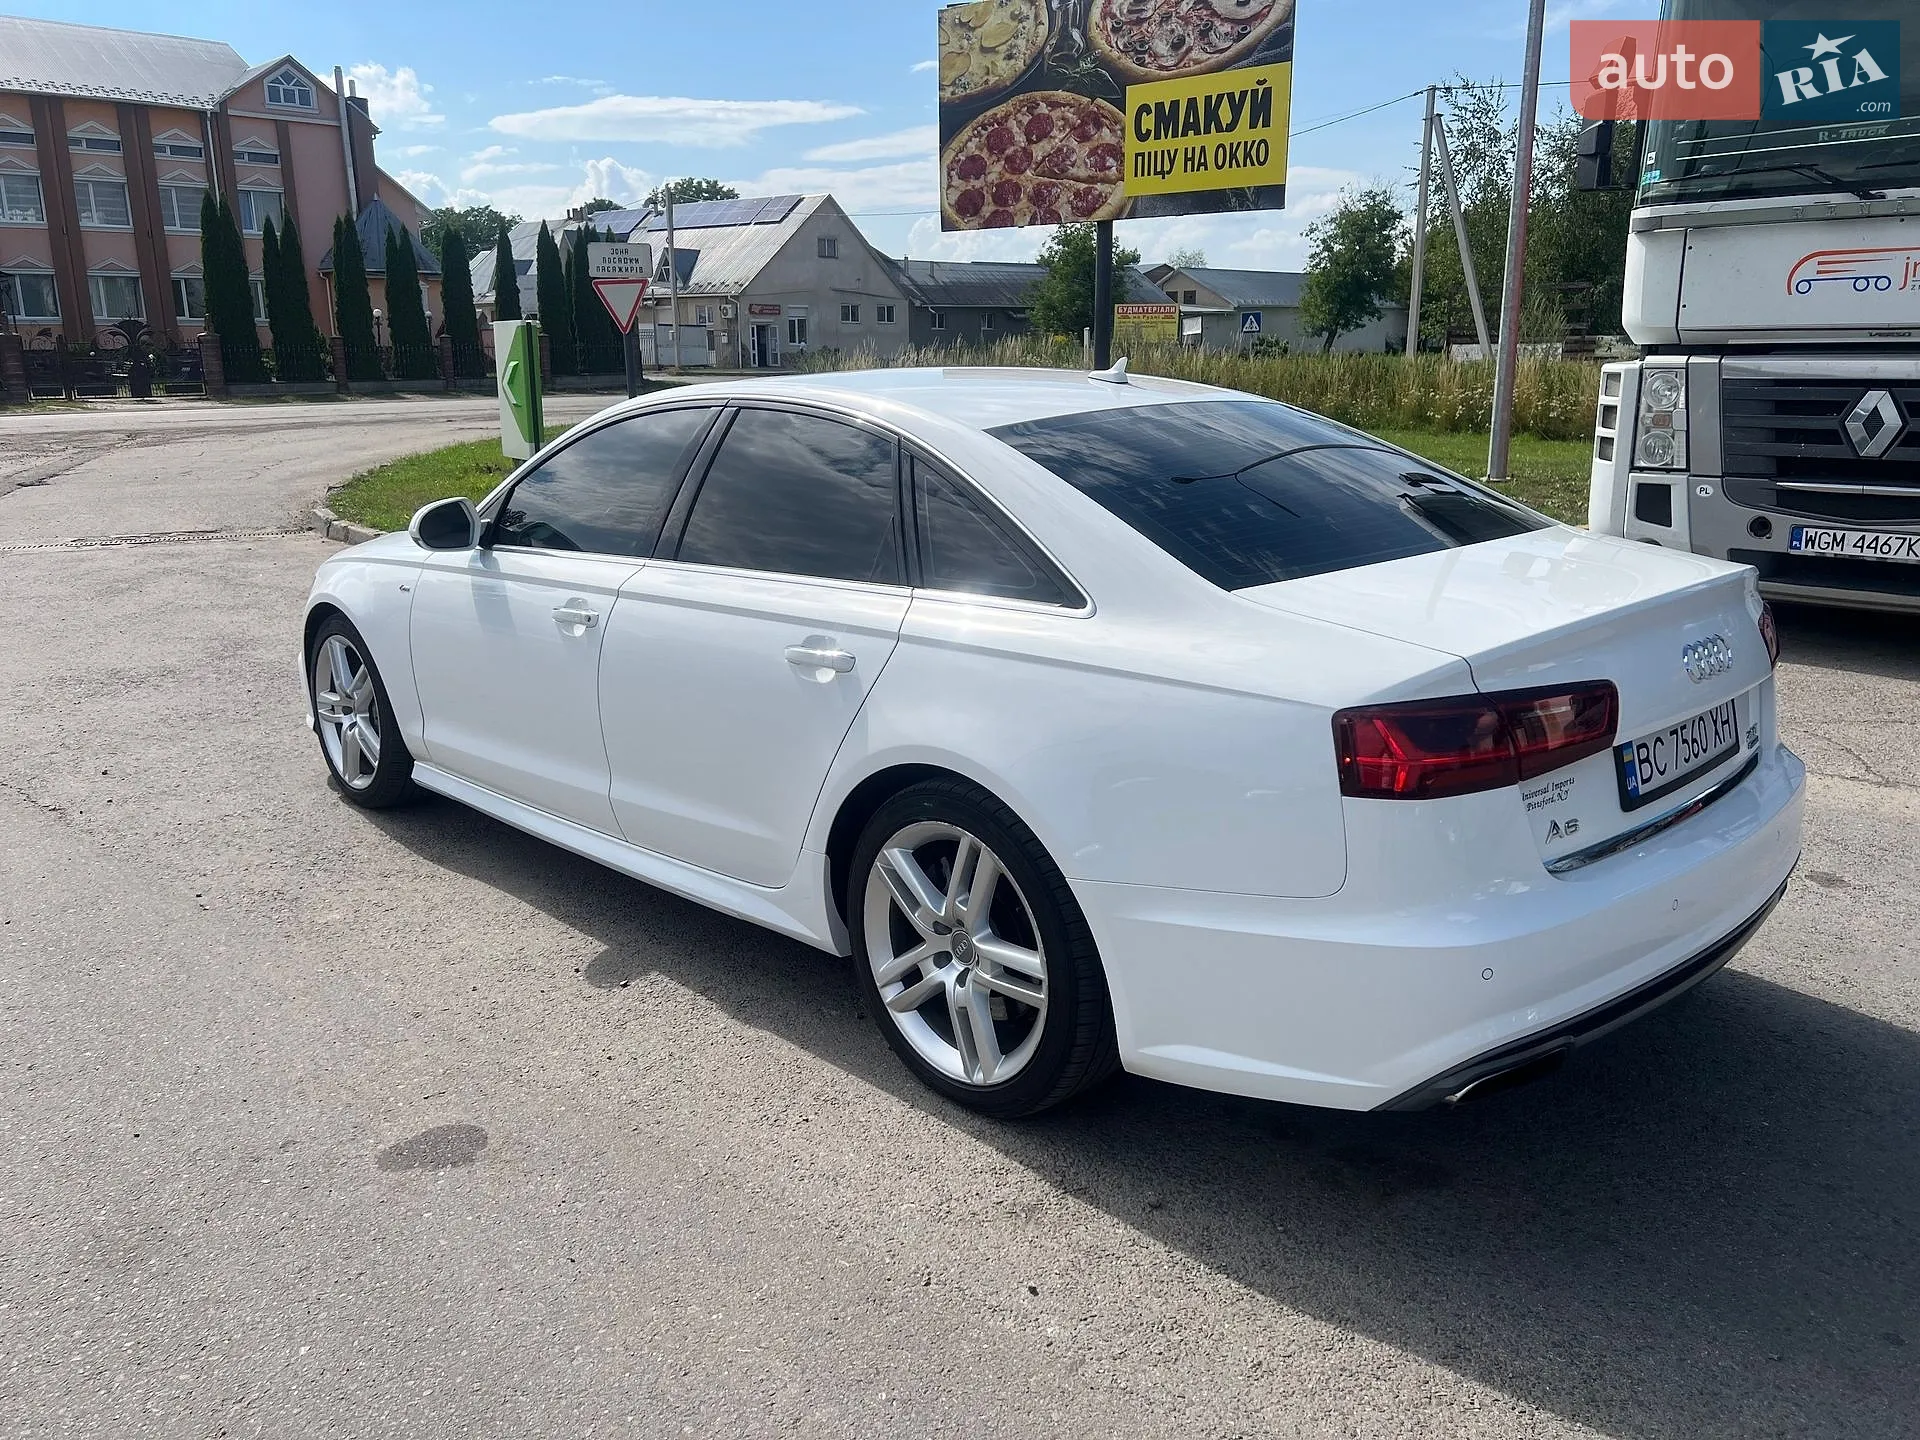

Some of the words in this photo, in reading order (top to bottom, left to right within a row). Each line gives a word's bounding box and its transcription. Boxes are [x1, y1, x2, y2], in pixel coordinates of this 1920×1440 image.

[1134, 78, 1273, 142] СМАКУЙ
[1134, 148, 1178, 179] ПІЦУ
[1184, 145, 1208, 173] НА
[1214, 138, 1269, 170] ОККО
[602, 256, 640, 265] ПОСАДКИ
[596, 265, 644, 273] ПАСАЖИРІВ
[1118, 306, 1175, 314] БУДМАТЕРІАЛИ
[1699, 486, 1710, 495] PL
[1804, 530, 1846, 552] WGM
[1852, 534, 1919, 557] 4467K
[1636, 736, 1667, 785] BC
[1669, 715, 1708, 770] 7560
[1709, 702, 1732, 748] XH
[1551, 777, 1575, 791] Imports
[1626, 776, 1637, 790] UA
[1545, 818, 1580, 844] A6
